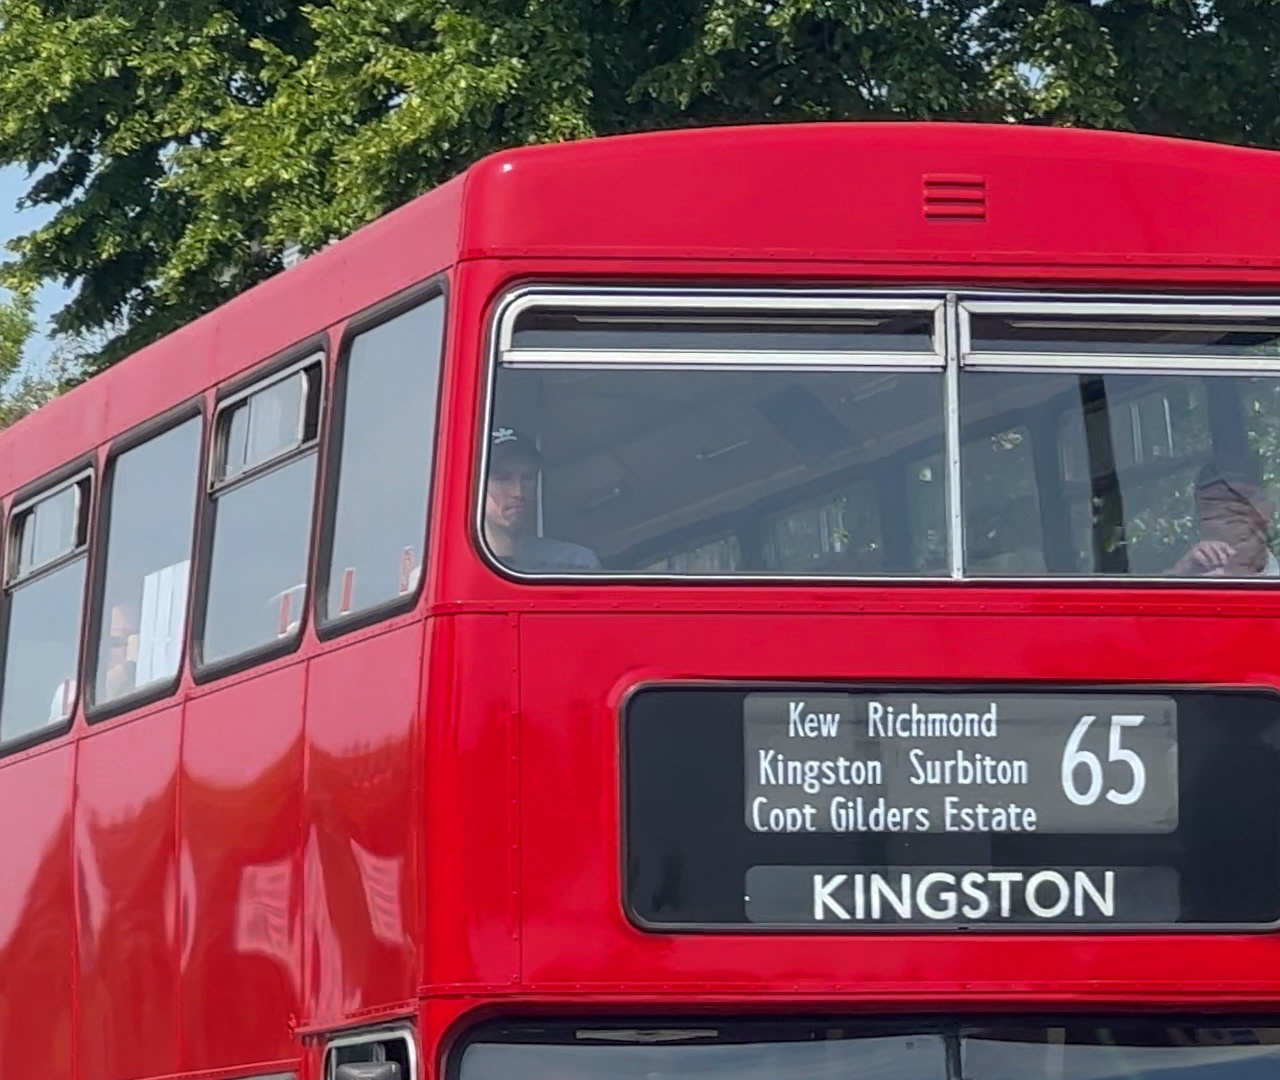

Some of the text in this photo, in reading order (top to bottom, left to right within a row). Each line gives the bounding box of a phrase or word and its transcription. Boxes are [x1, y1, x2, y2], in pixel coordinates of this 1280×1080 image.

[788, 702, 998, 738] Kew Richmond
[759, 749, 1029, 793] Kingston Surbiton
[1061, 714, 1147, 806] 65
[830, 797, 930, 832] Gilders
[943, 796, 1038, 832] Estate
[813, 870, 1116, 920] KINGSTON
